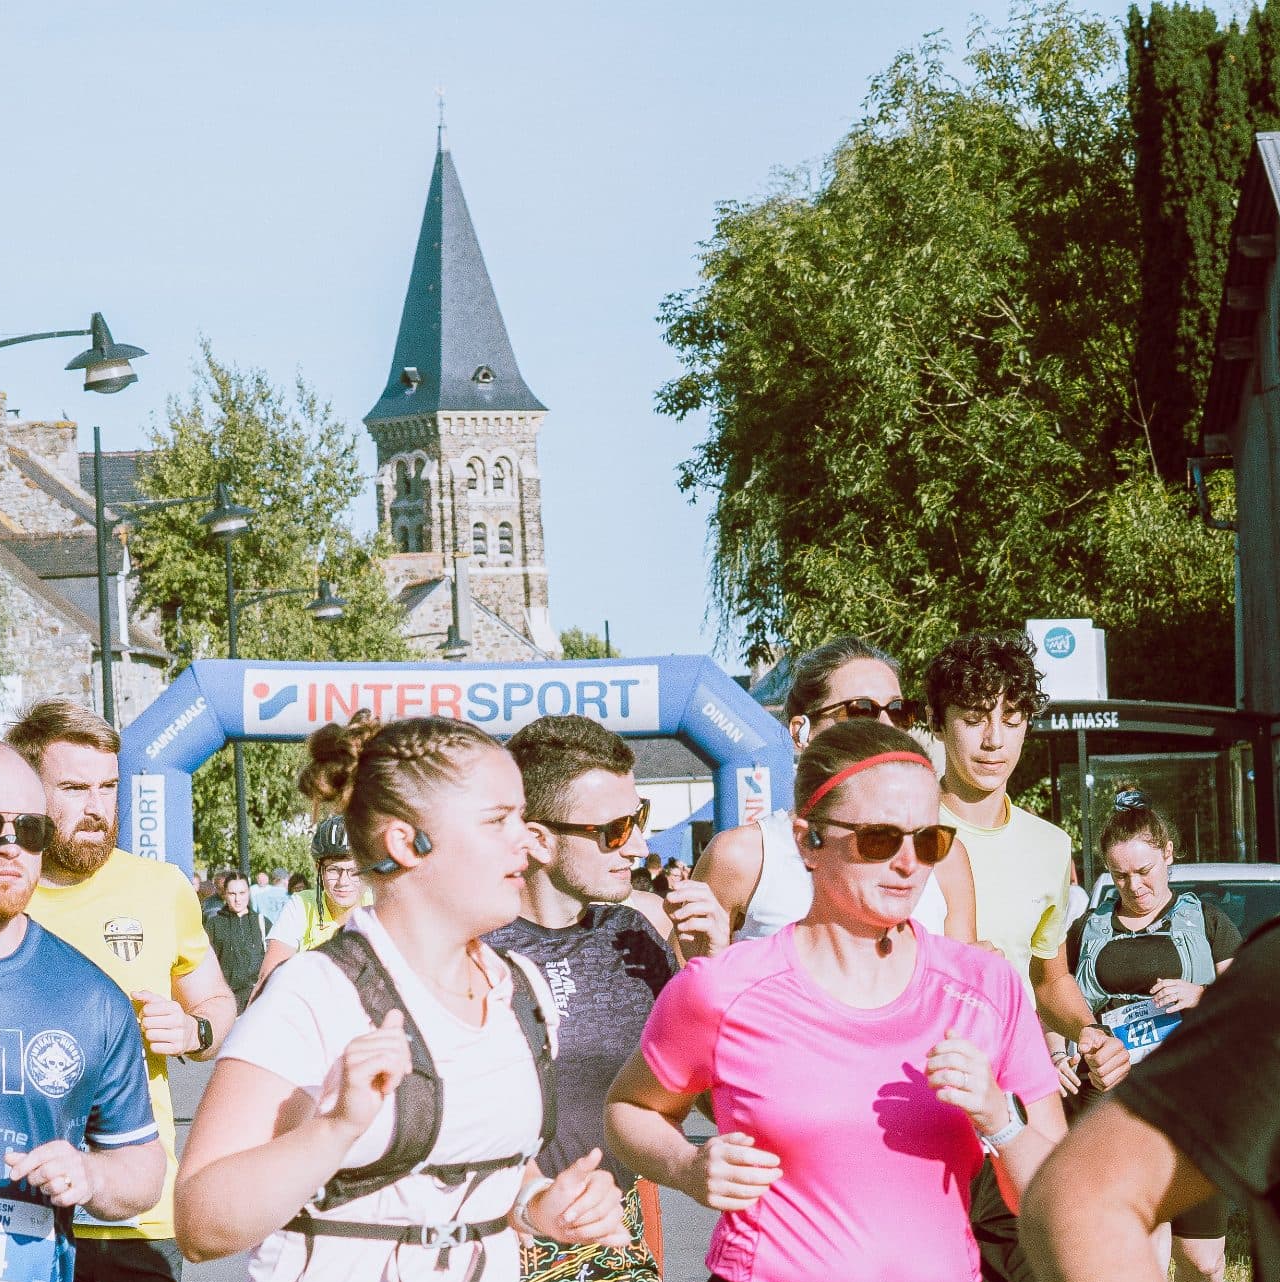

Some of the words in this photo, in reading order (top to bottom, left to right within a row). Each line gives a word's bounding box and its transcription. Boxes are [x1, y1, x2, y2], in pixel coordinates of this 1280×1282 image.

[308, 679, 640, 722] INTERSPORT
[1051, 713, 1069, 729] LA
[1072, 712, 1119, 729] MASSE
[702, 703, 745, 744] DINAN
[556, 957, 576, 997] TRAIL
[1128, 1019, 1159, 1047] 421
